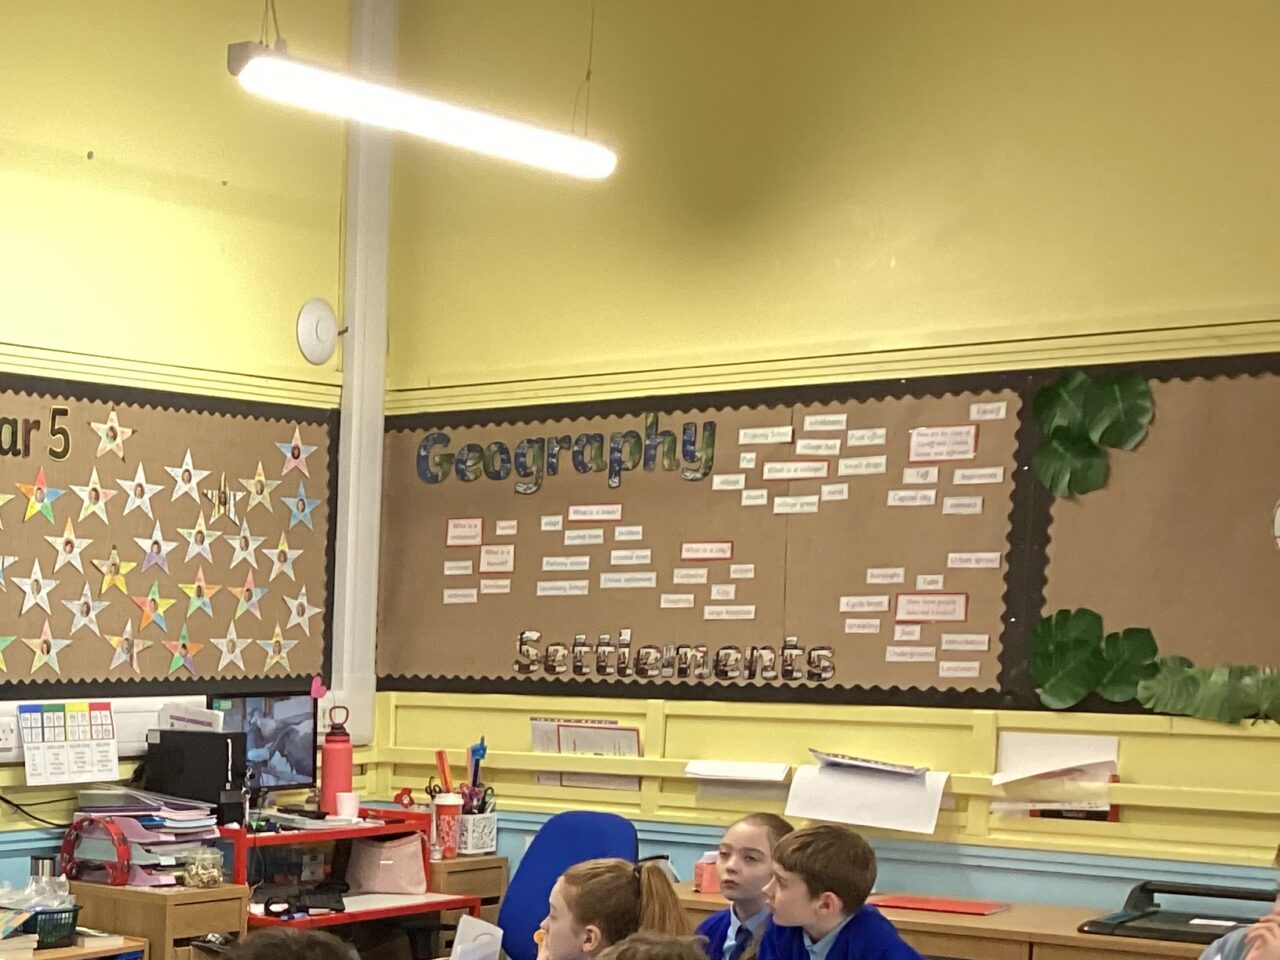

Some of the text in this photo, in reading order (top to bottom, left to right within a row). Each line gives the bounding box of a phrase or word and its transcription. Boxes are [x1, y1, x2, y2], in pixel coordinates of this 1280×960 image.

[47, 405, 71, 461] 5
[416, 411, 716, 495] Geography
[513, 628, 836, 682] Settlements
